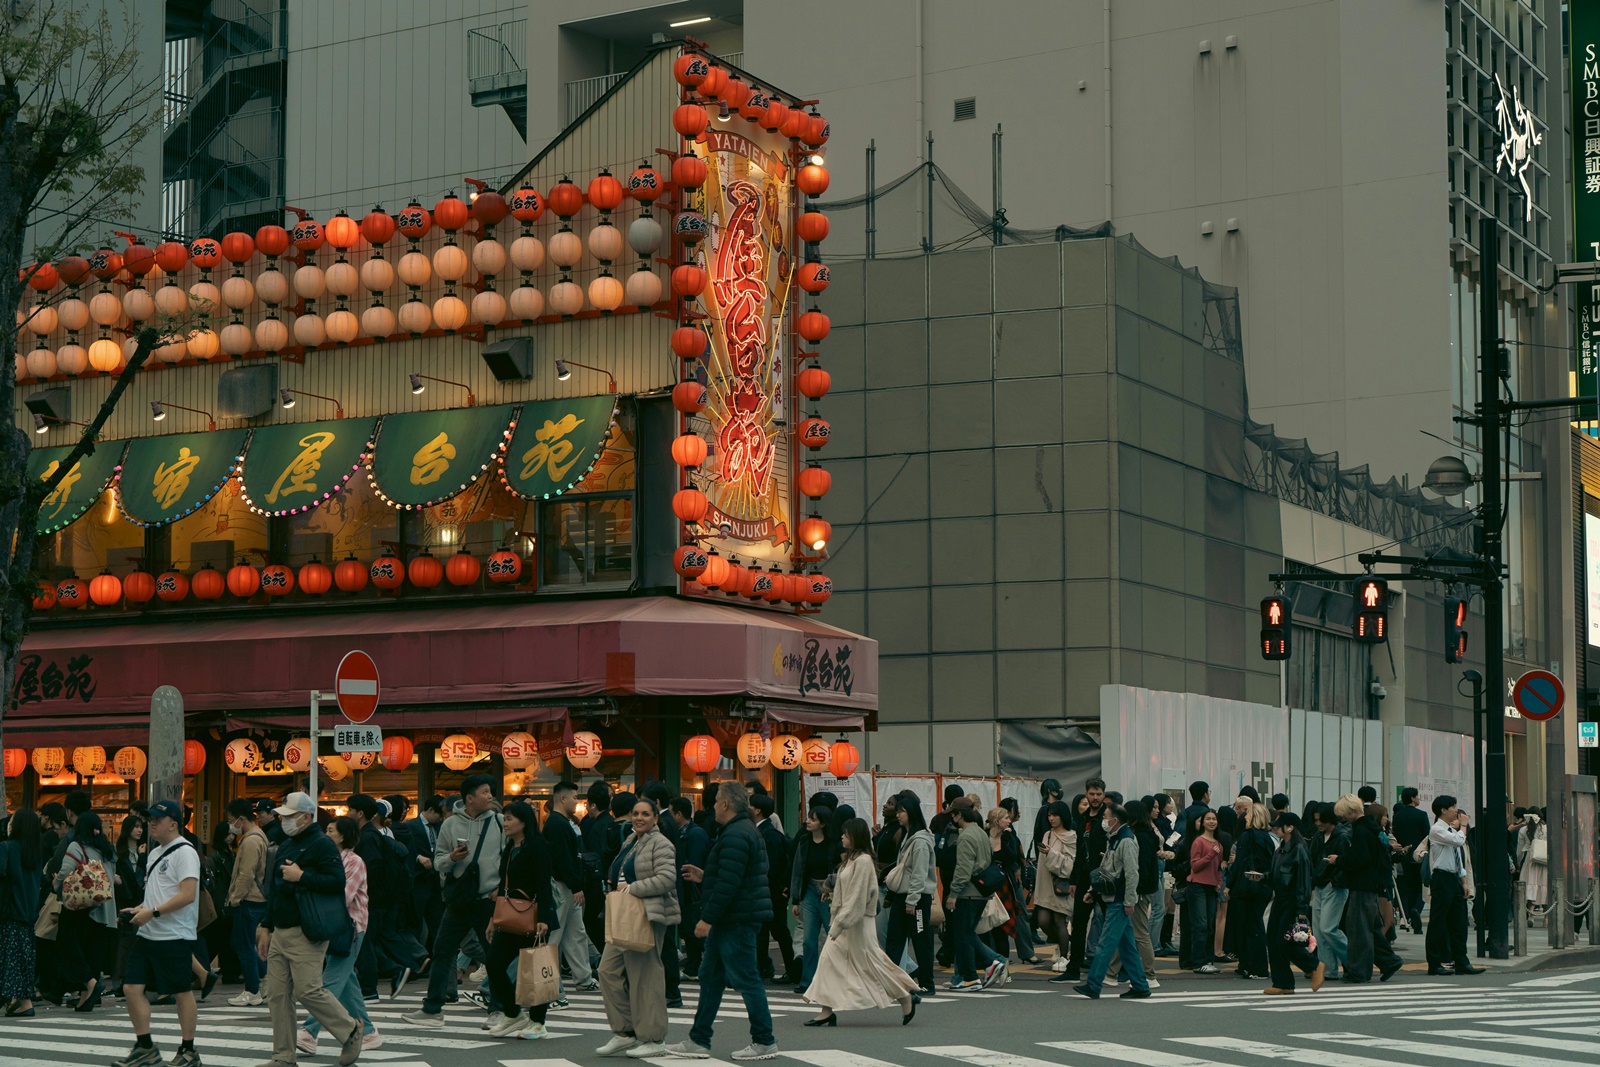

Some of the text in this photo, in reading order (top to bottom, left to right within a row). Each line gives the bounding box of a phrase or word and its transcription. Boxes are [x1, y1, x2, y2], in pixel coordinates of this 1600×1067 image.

[714, 133, 769, 171] YATAIEN
[11, 653, 98, 711] 屋台苑
[338, 731, 381, 747] 自転車を除く
[242, 743, 255, 768] くろ松
[453, 742, 475, 755] RS
[503, 747, 521, 758] RS
[782, 740, 794, 765] くろ松
[806, 752, 826, 763] RS
[541, 966, 554, 979] GU
